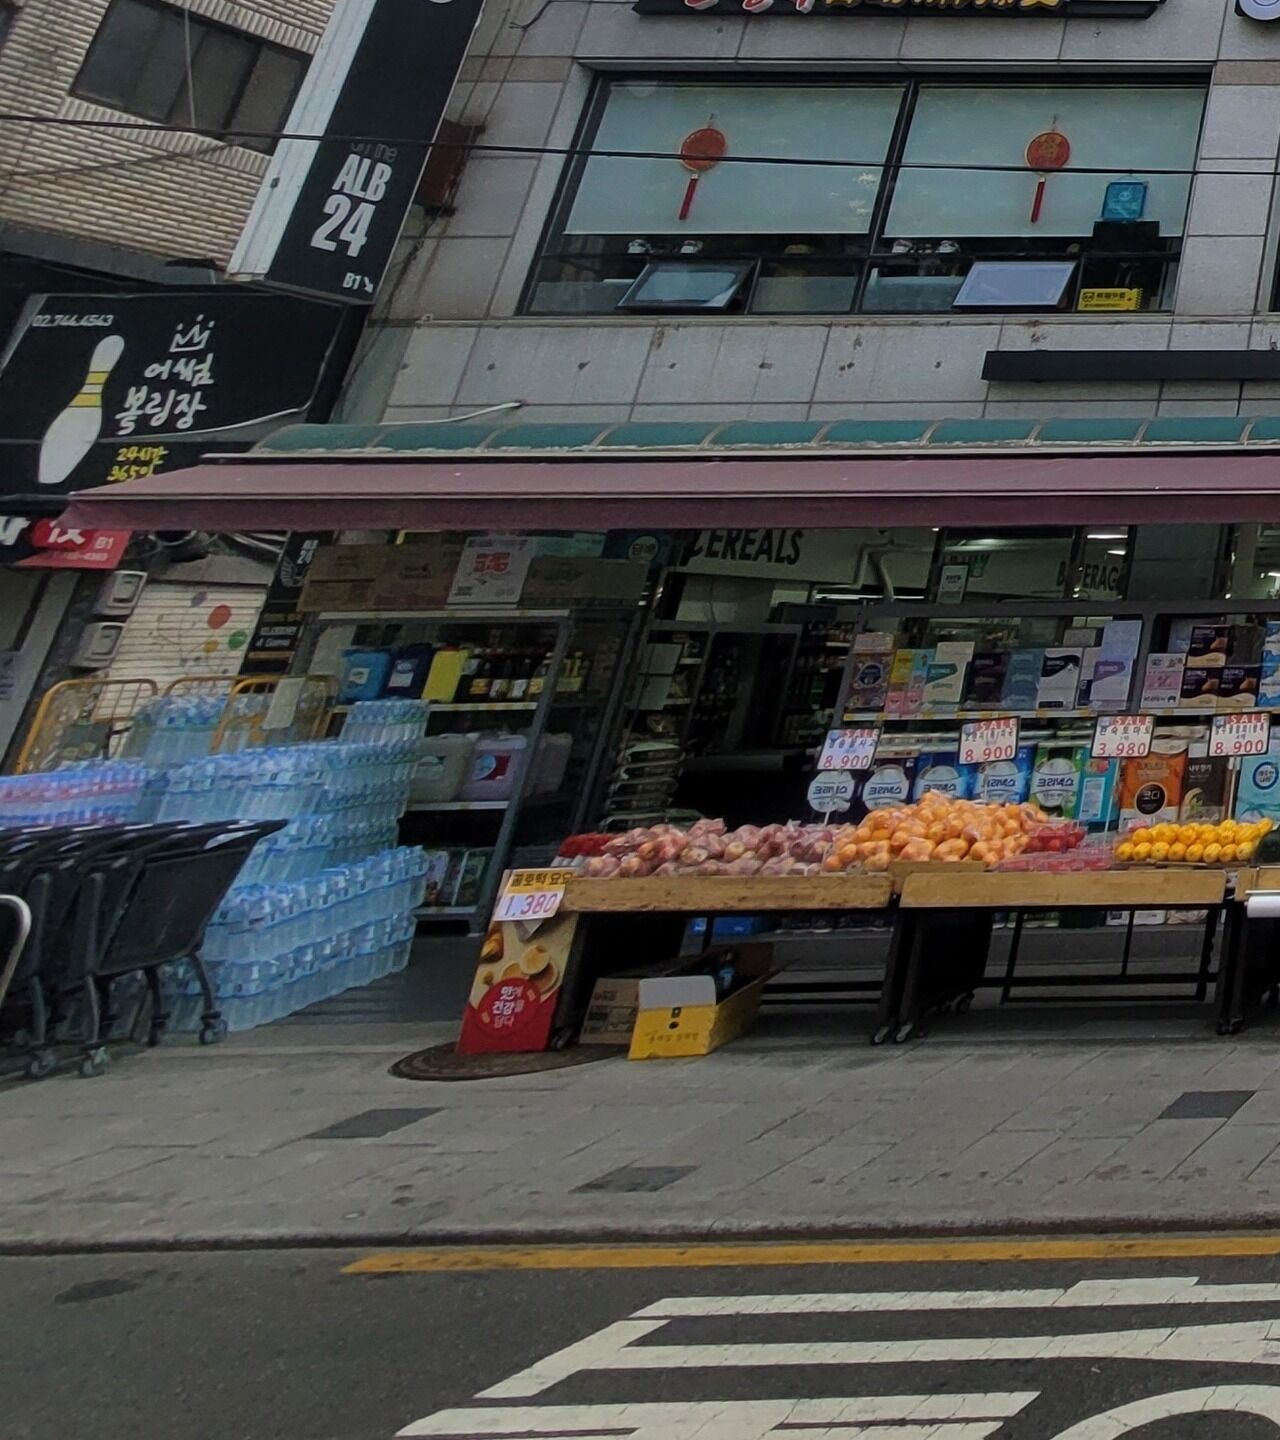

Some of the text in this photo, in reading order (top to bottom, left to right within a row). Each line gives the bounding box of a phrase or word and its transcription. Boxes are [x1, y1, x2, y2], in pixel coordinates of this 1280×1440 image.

[330, 152, 392, 203] ALB
[309, 193, 377, 258] 24
[342, 270, 363, 292] B1
[114, 385, 208, 436] 볼링장
